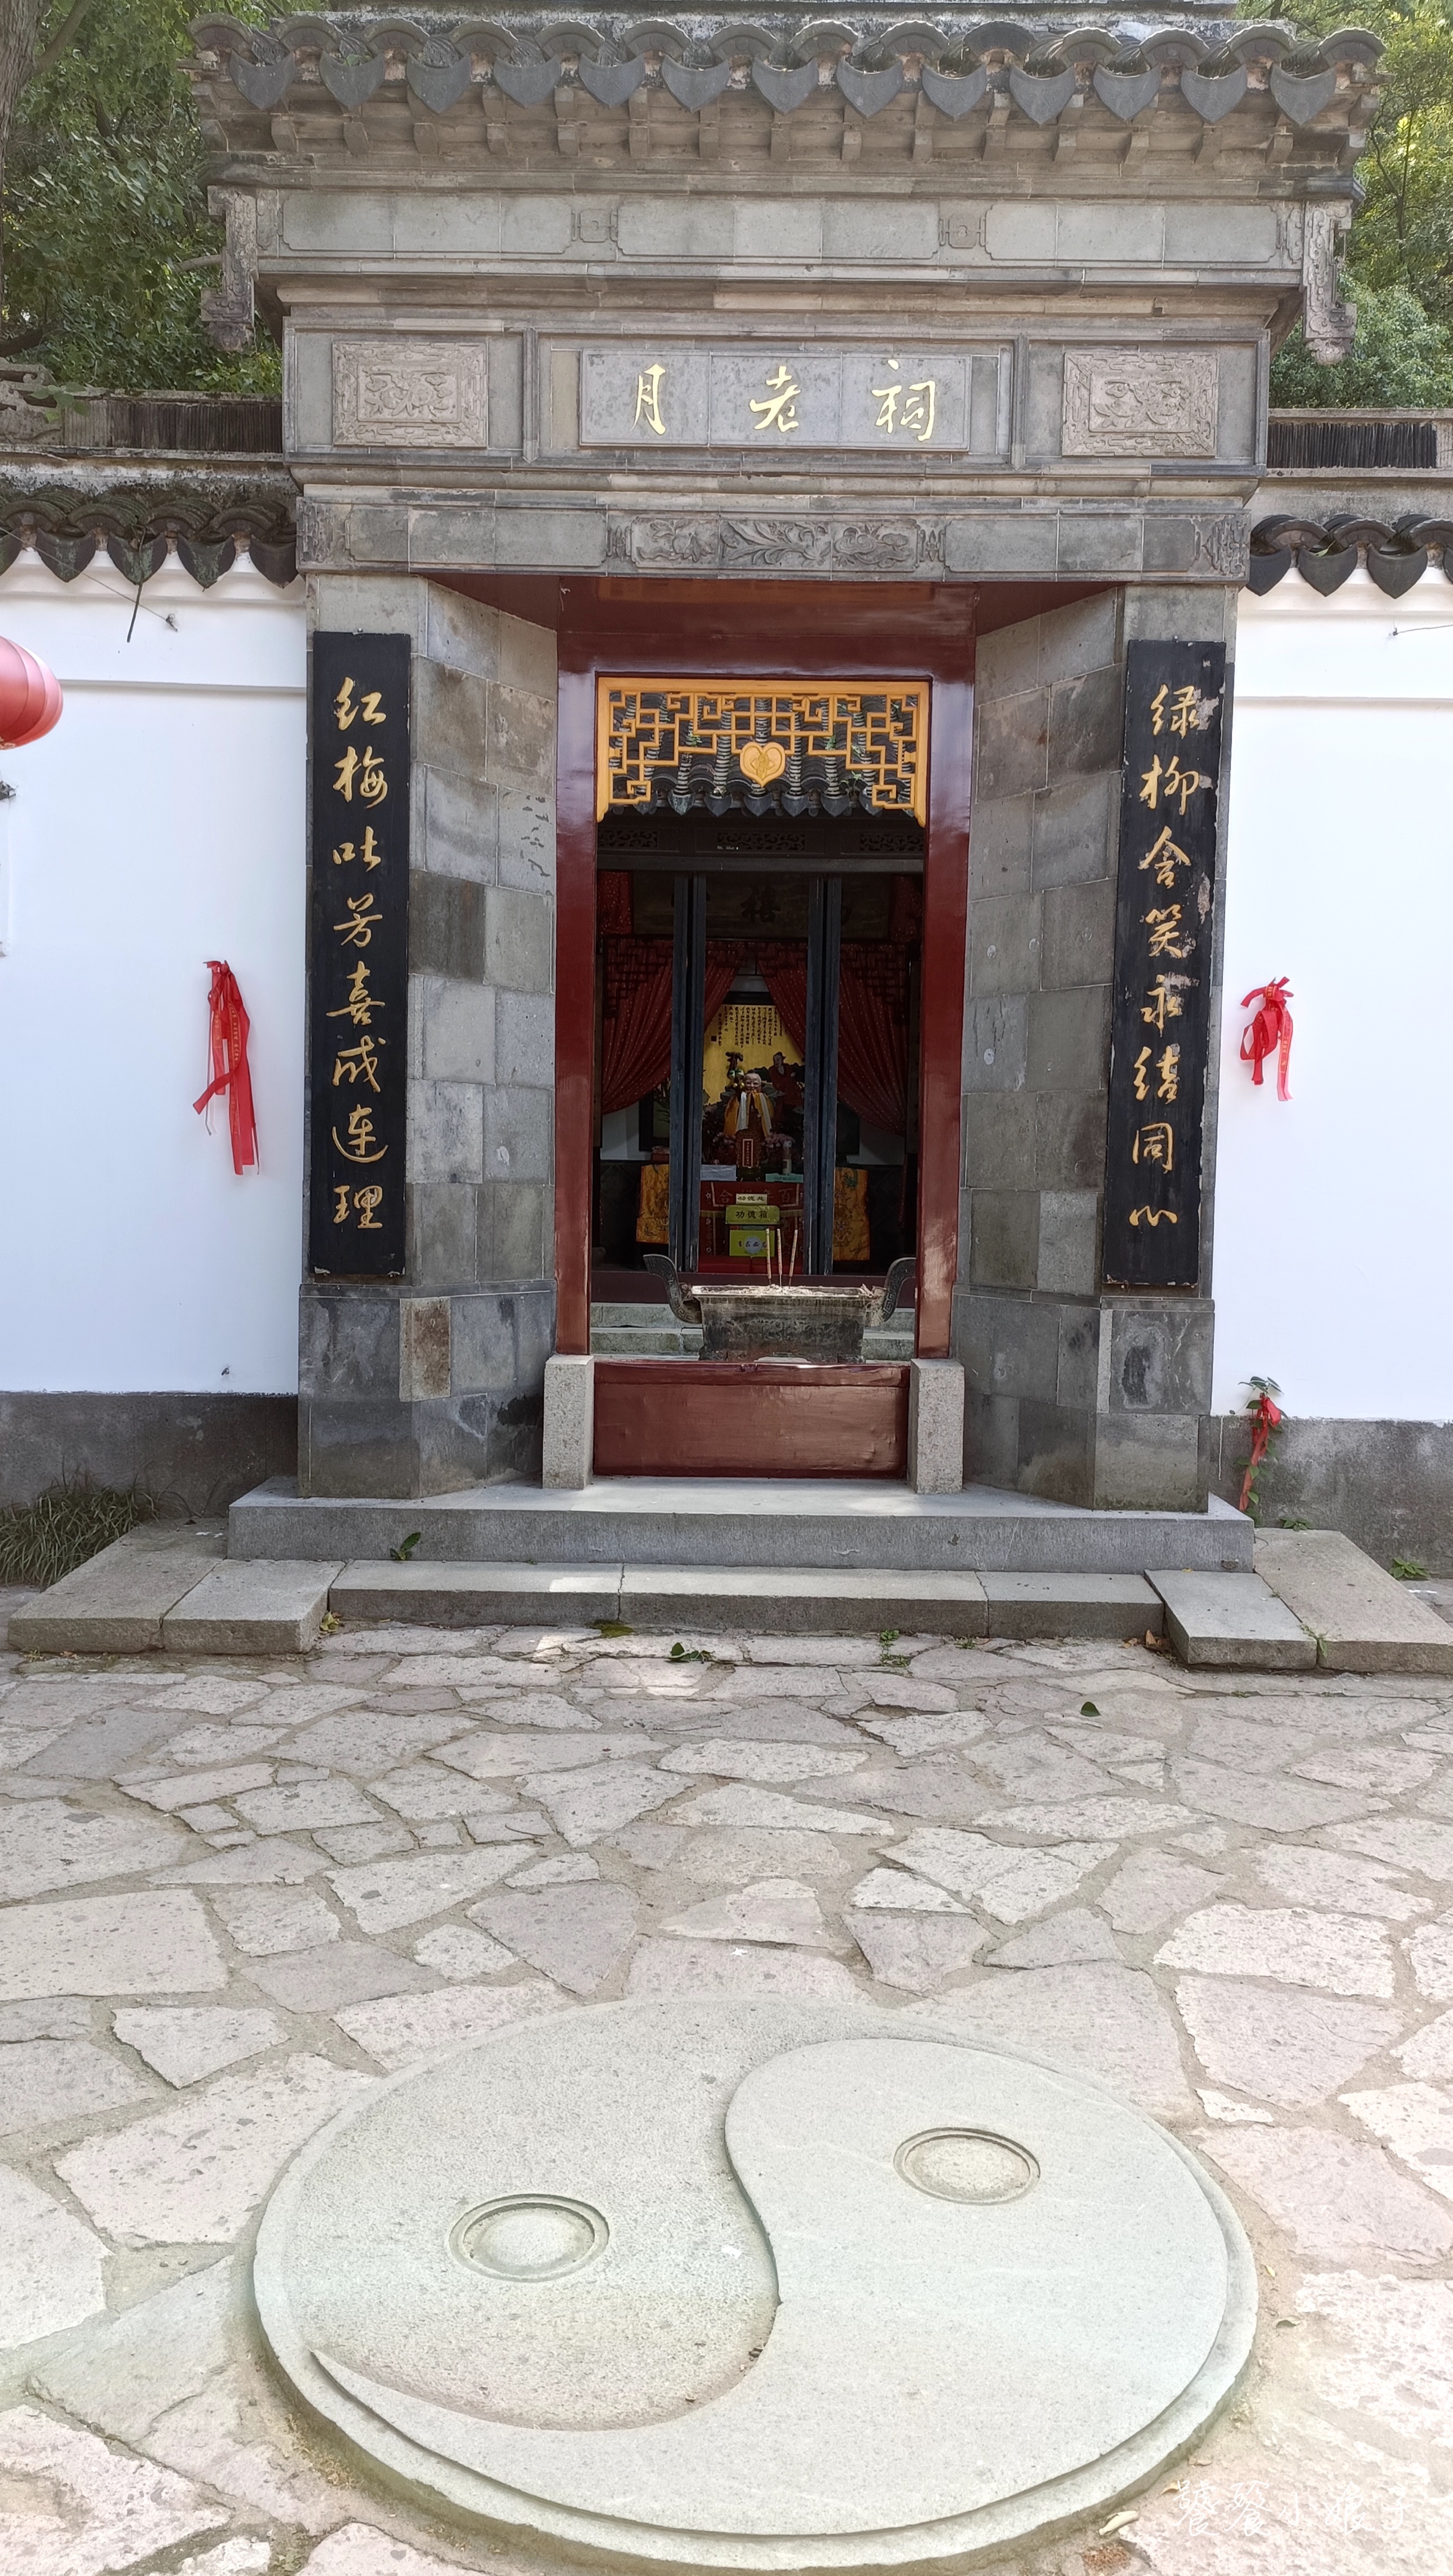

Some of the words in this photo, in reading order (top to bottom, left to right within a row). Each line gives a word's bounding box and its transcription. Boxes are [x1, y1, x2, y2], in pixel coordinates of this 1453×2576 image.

[629, 359, 935, 442] 月老祠
[1128, 684, 1200, 1227] 绿柳含笑永结同心
[735, 1210, 768, 1220] 功德箱
